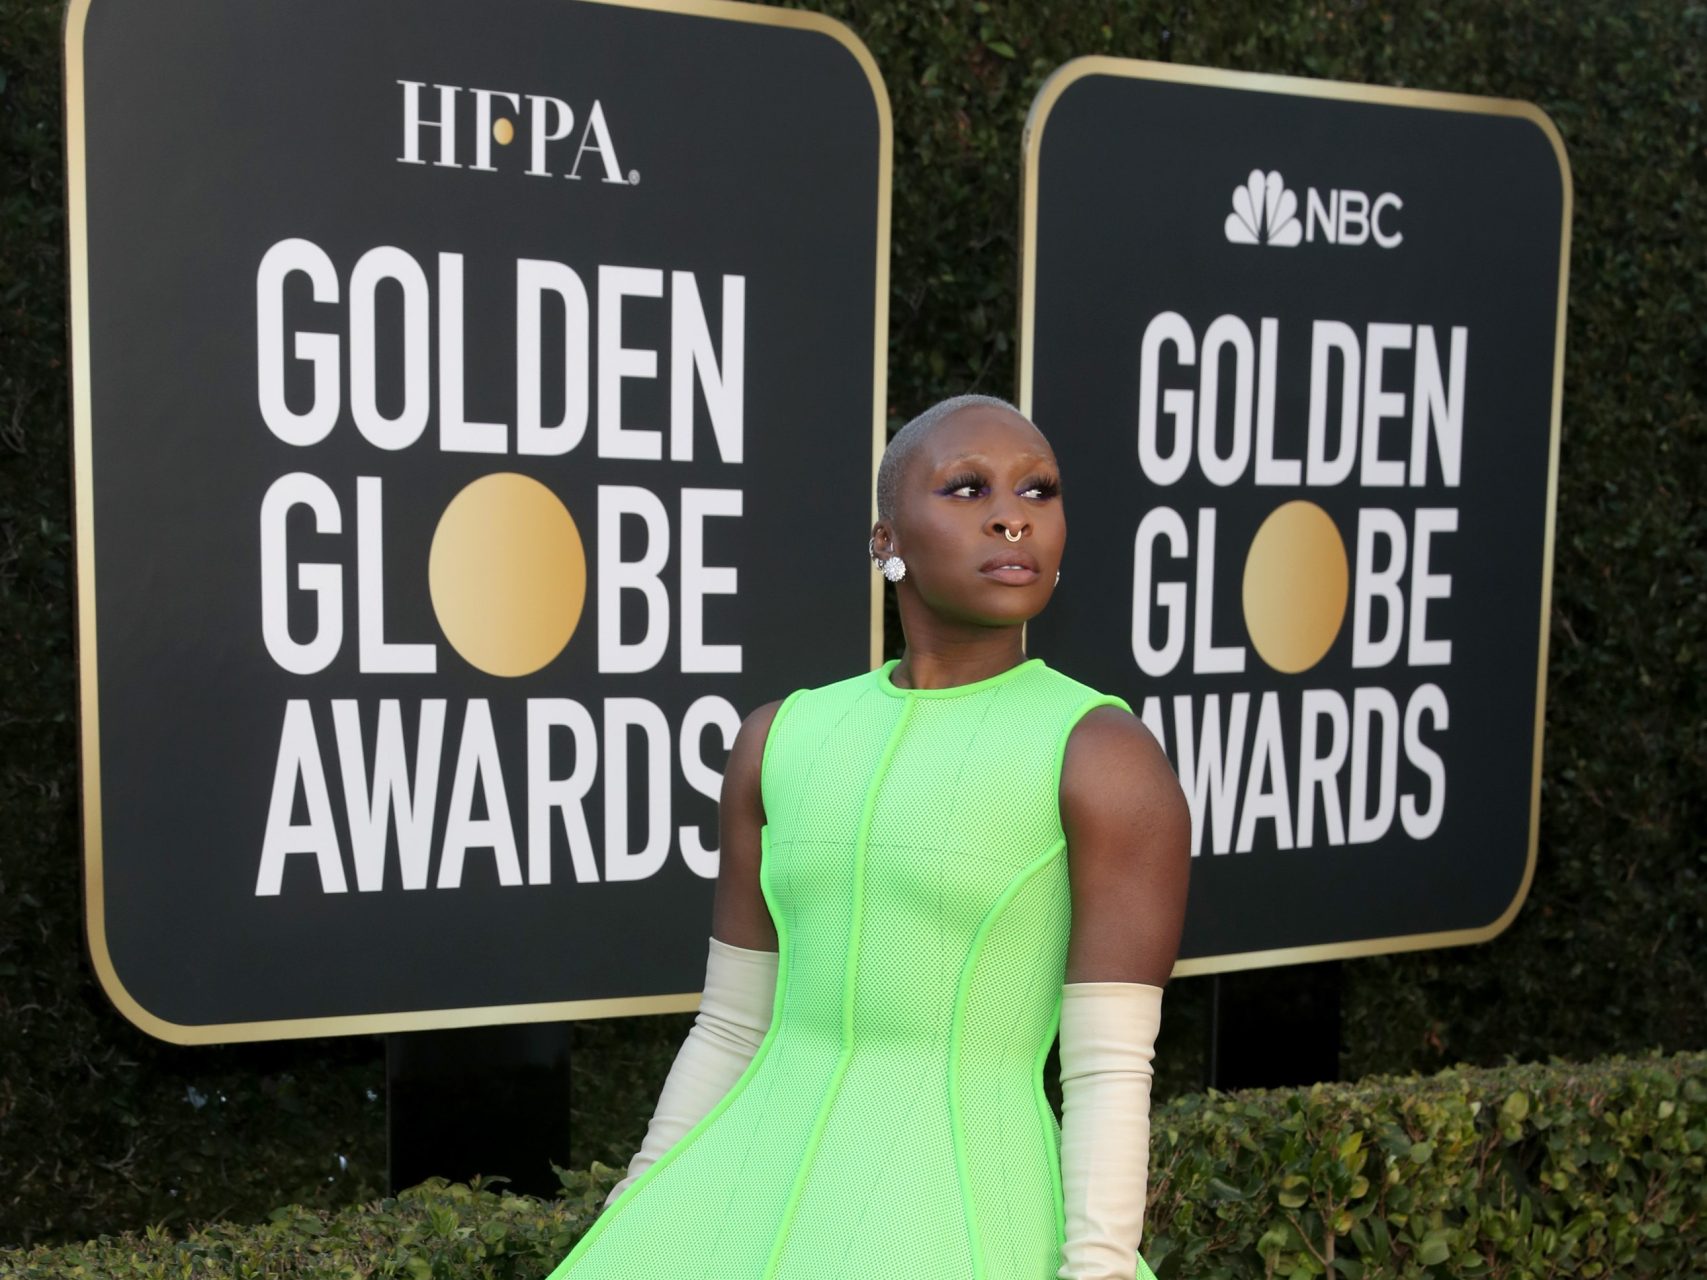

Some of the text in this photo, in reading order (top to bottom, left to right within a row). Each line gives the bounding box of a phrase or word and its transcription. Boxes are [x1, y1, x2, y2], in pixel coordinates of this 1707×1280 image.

[1305, 187, 1403, 249] NBC
[256, 237, 746, 464] GOLDEN
[1137, 310, 1468, 488] GOLDEN
[259, 471, 744, 679] GLOBE
[1131, 500, 1459, 677] GLOBE
